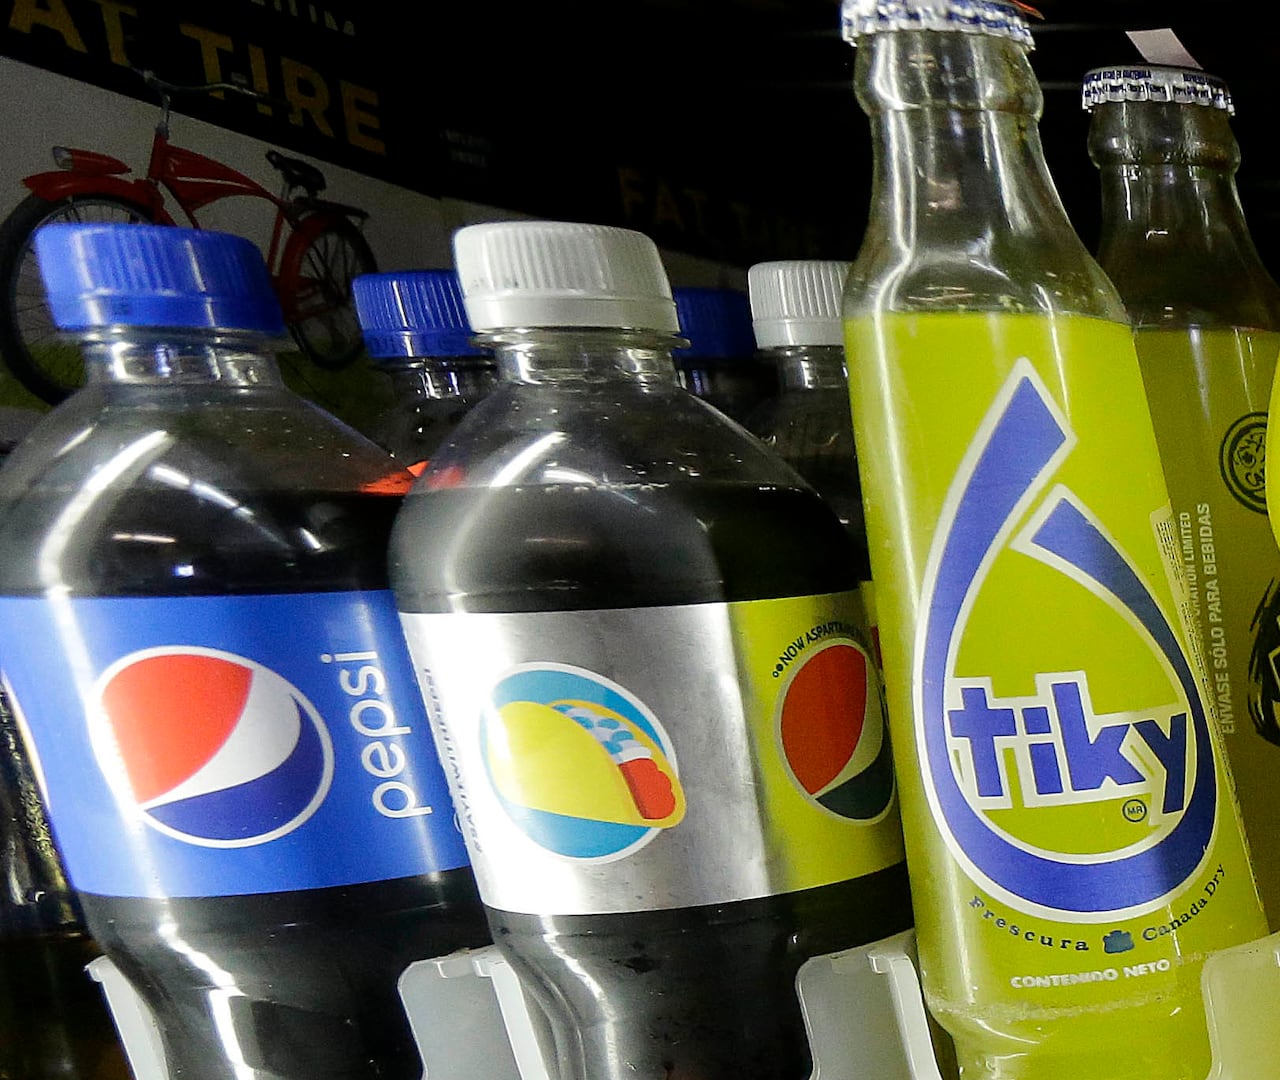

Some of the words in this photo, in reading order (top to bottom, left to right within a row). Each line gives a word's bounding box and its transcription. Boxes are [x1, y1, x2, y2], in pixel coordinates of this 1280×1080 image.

[180, 23, 387, 157] TIRE
[1180, 512, 1196, 562] LIMITED
[1197, 503, 1217, 575] BEBIDAS
[1204, 578, 1223, 623] PARA
[779, 636, 806, 667] NOW
[321, 651, 432, 819] pepsi
[1215, 673, 1235, 735] ENVASE
[947, 681, 1188, 815] tiky
[968, 895, 1091, 952] Frescura
[1142, 897, 1209, 943] Canada
[1204, 863, 1227, 898] Dry
[1010, 969, 1119, 989] CONTENIDO
[1123, 958, 1171, 978] NETO
